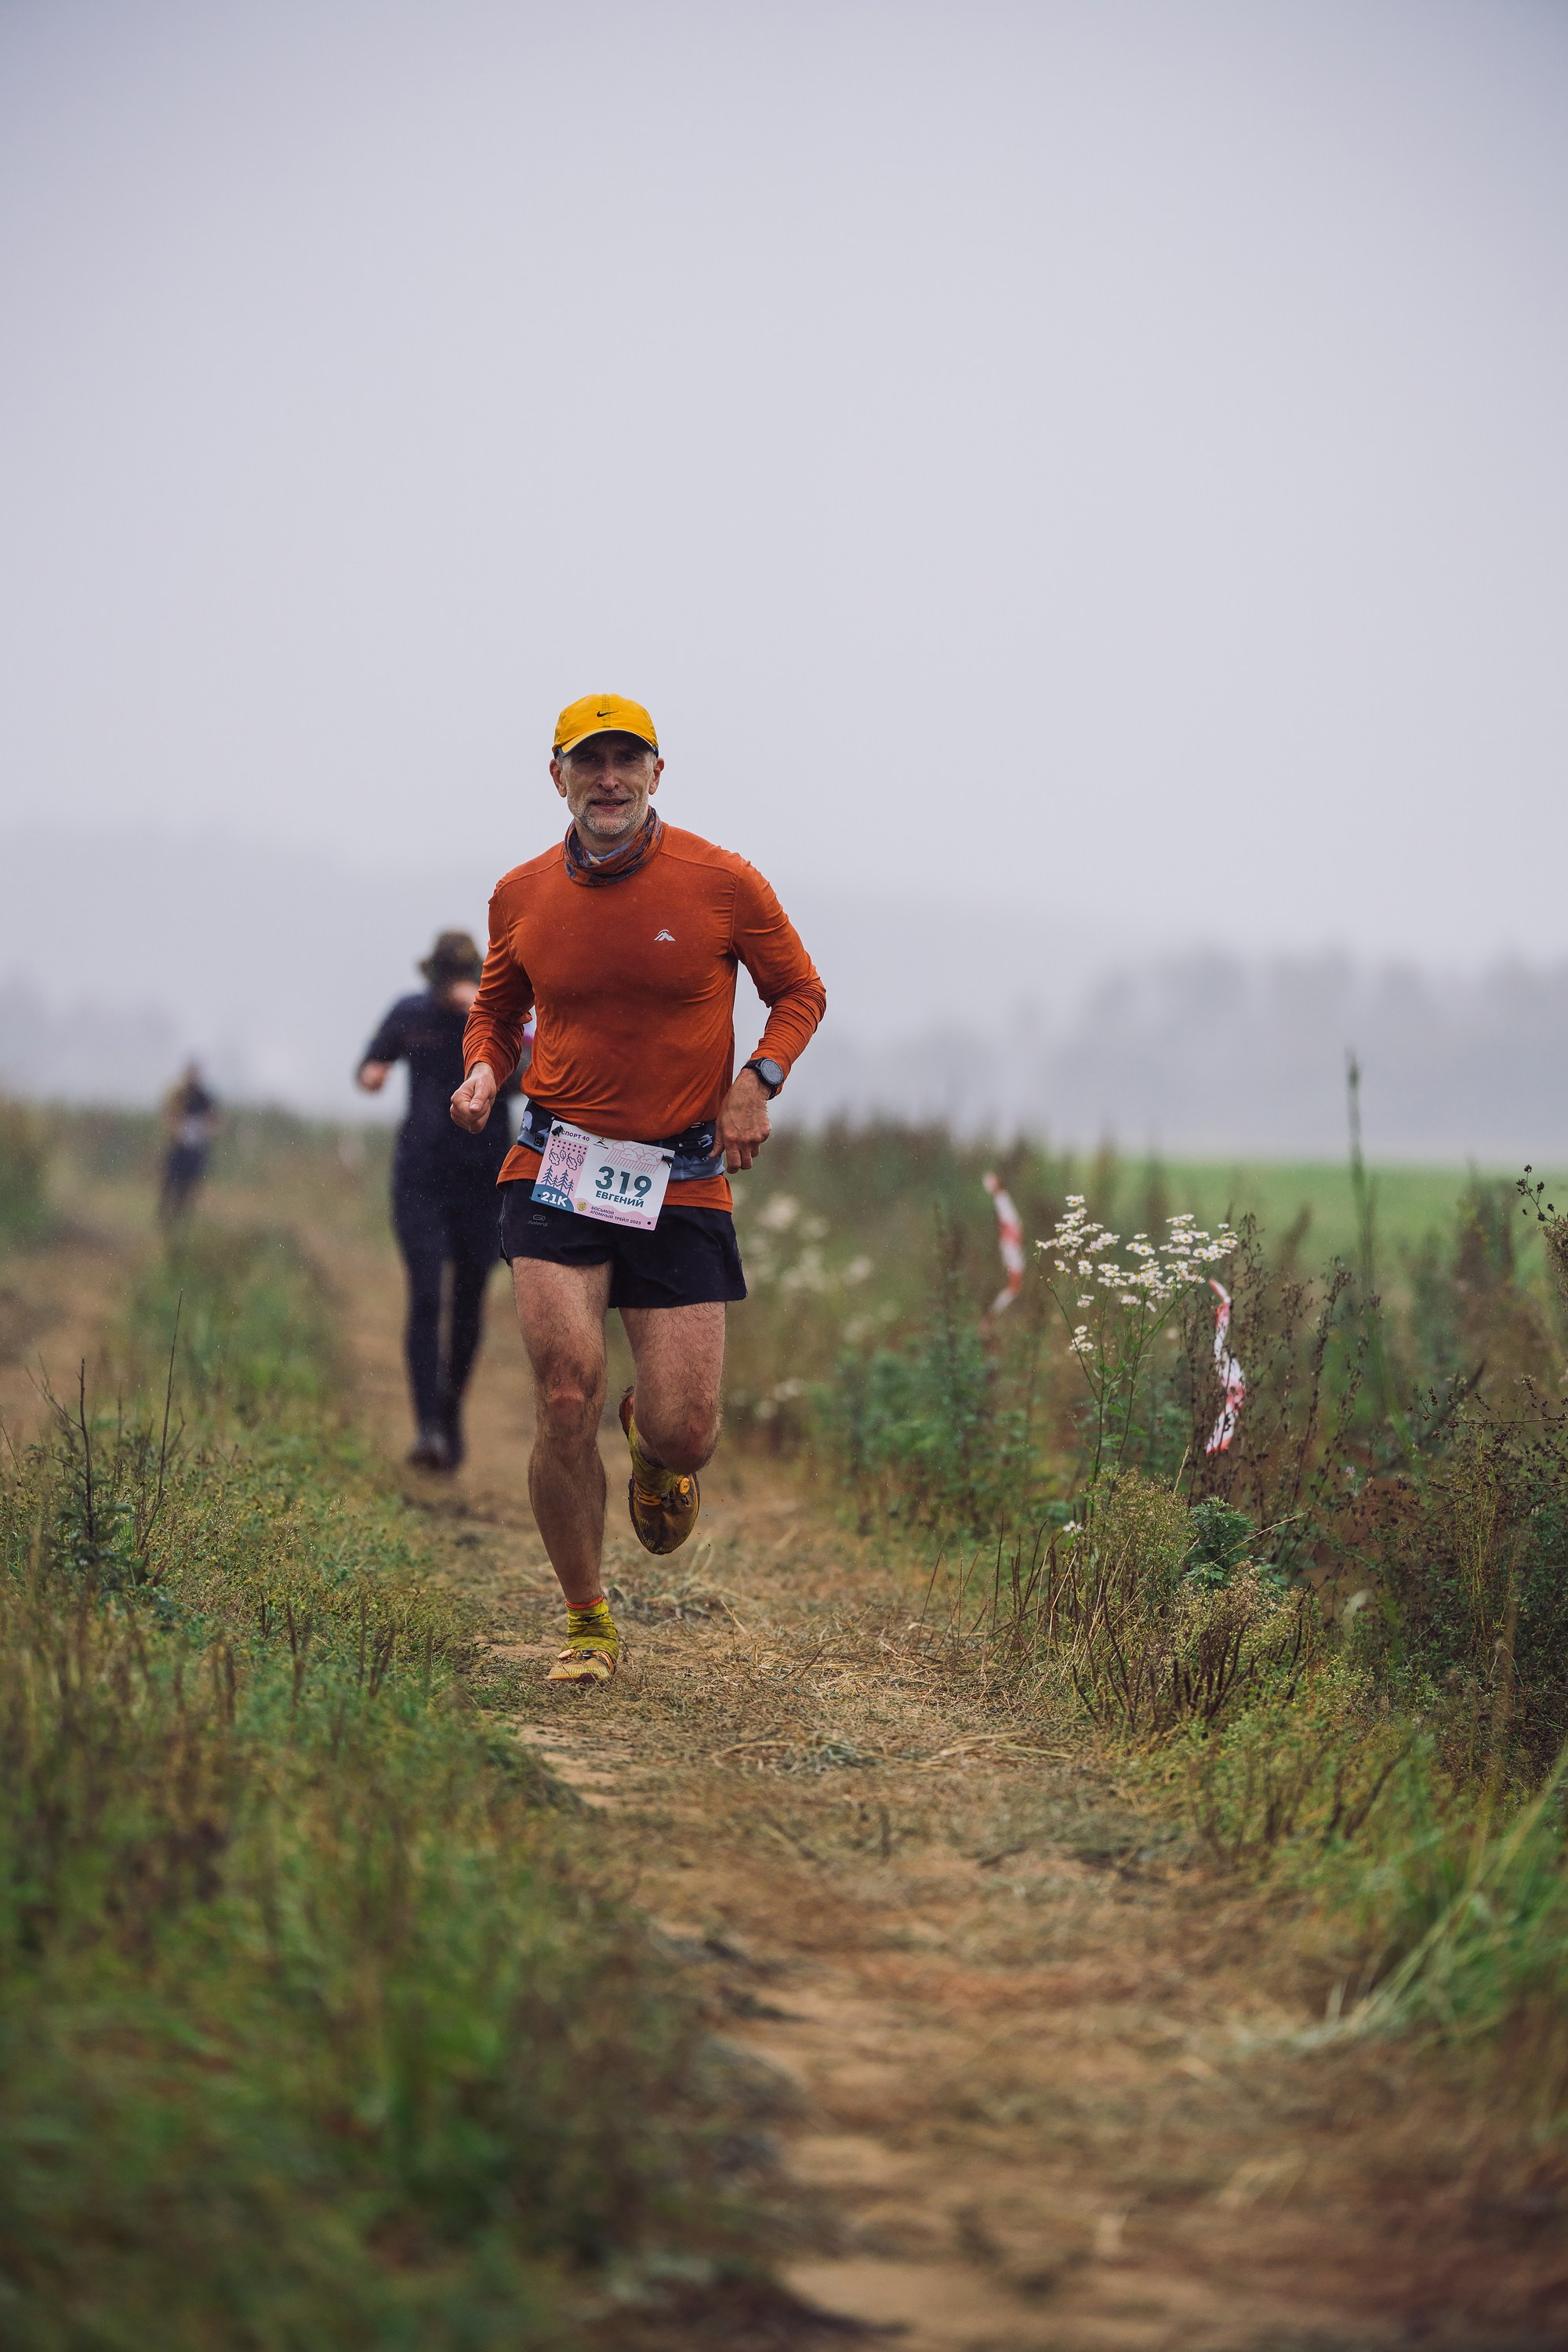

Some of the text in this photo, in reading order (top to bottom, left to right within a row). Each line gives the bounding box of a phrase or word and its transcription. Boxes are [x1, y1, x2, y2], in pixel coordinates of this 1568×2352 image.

[595, 1166, 652, 1198] 319
[596, 1190, 644, 1208] ЕВГЕНИЙ
[590, 1206, 615, 1215] ВОСЬМОЙ
[590, 1210, 614, 1219] АТОМНЫЙ
